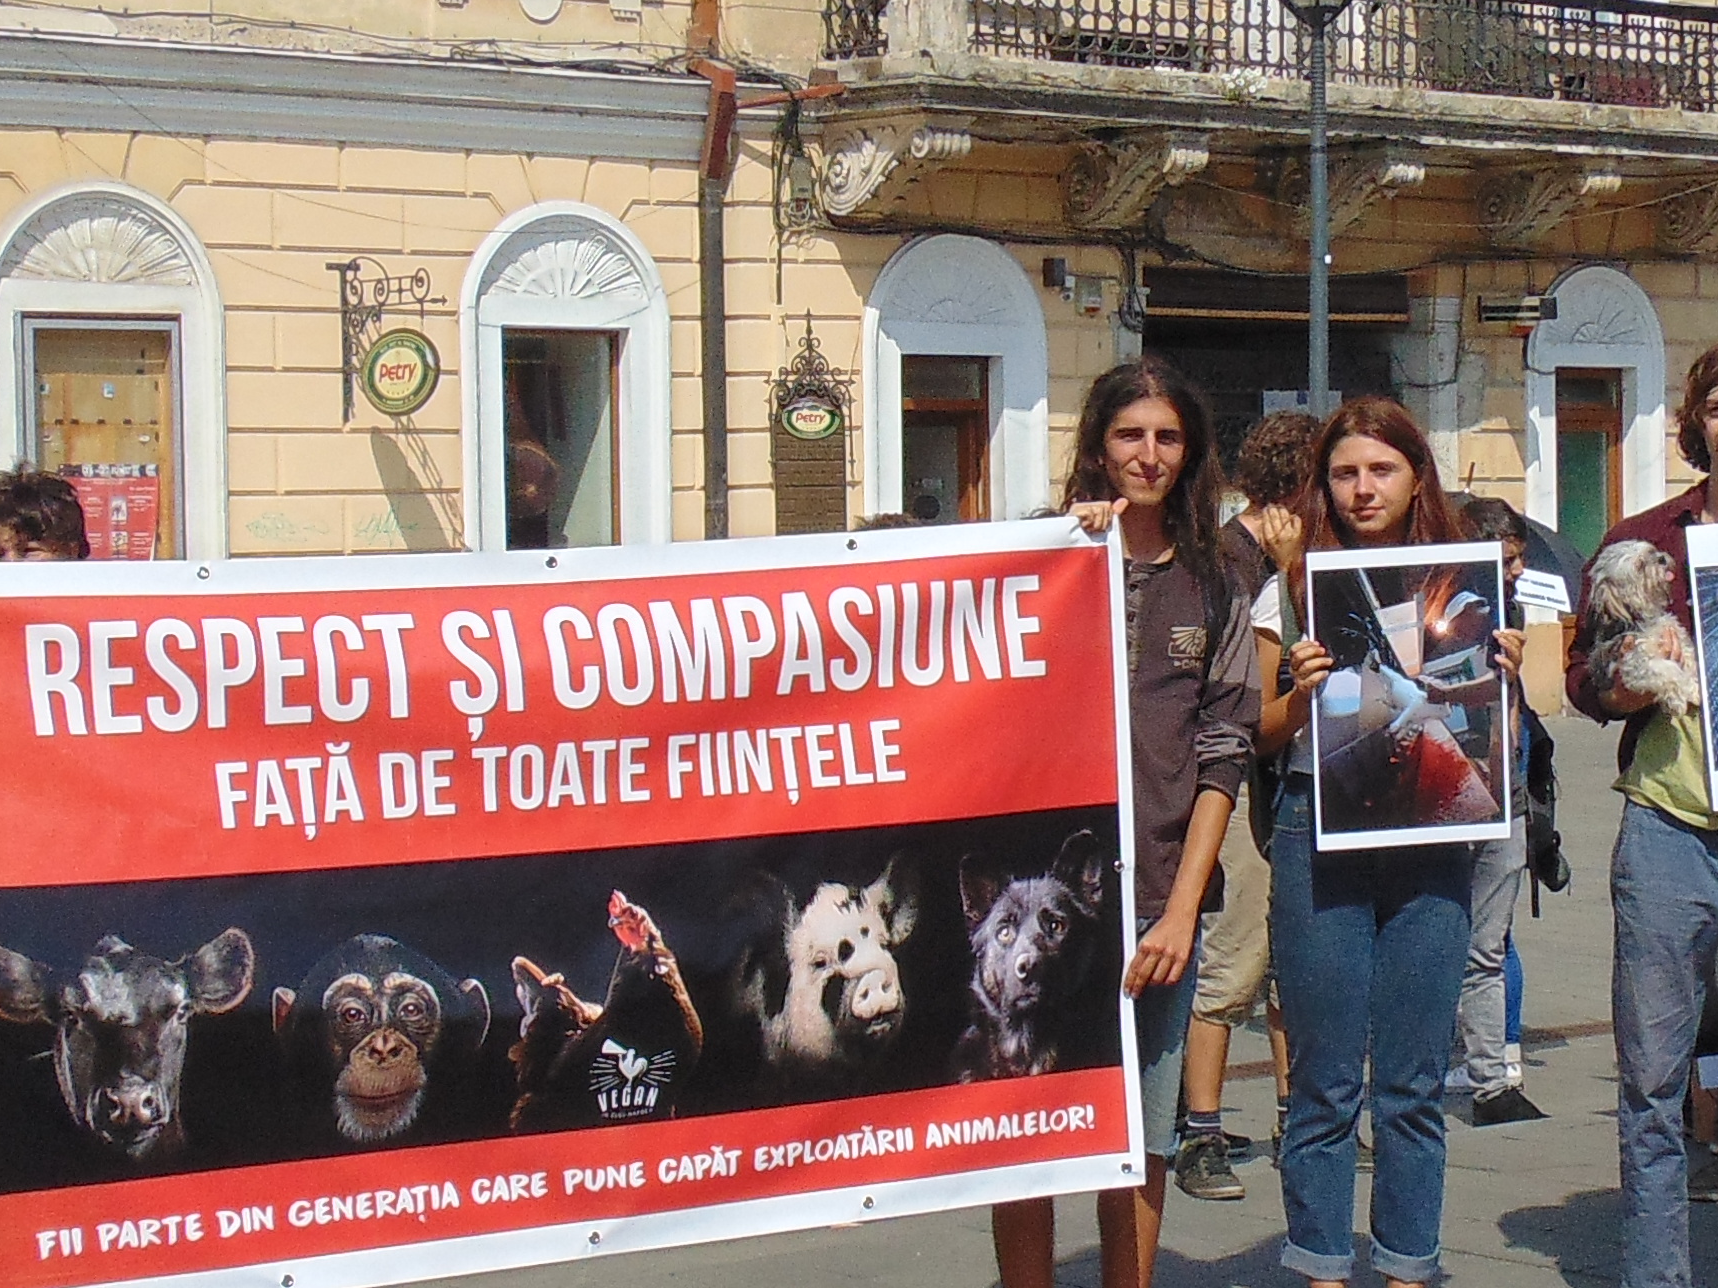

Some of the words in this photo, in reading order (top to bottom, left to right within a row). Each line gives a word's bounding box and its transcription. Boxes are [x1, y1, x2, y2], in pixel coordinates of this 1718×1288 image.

[24, 612, 417, 738] RESPECT
[440, 609, 525, 742] ȘI
[542, 574, 1048, 710] COMPASIUNE
[214, 741, 365, 841] FAȚĂ
[378, 749, 457, 820] DE
[471, 737, 651, 812] TOATE
[667, 718, 907, 805] FIINȚELE
[597, 1086, 659, 1112] VEGAN
[35, 1227, 83, 1260] FII
[96, 1213, 204, 1252] PARTE
[216, 1204, 275, 1238] DIN
[287, 1181, 460, 1224] GENERAȚIA
[471, 1171, 549, 1205] CARE
[563, 1160, 647, 1194] PUNE
[658, 1144, 742, 1185] CAPĂT
[754, 1124, 914, 1172] EXPLOATĂRII
[925, 1104, 1095, 1149] ANIMALELOR!
